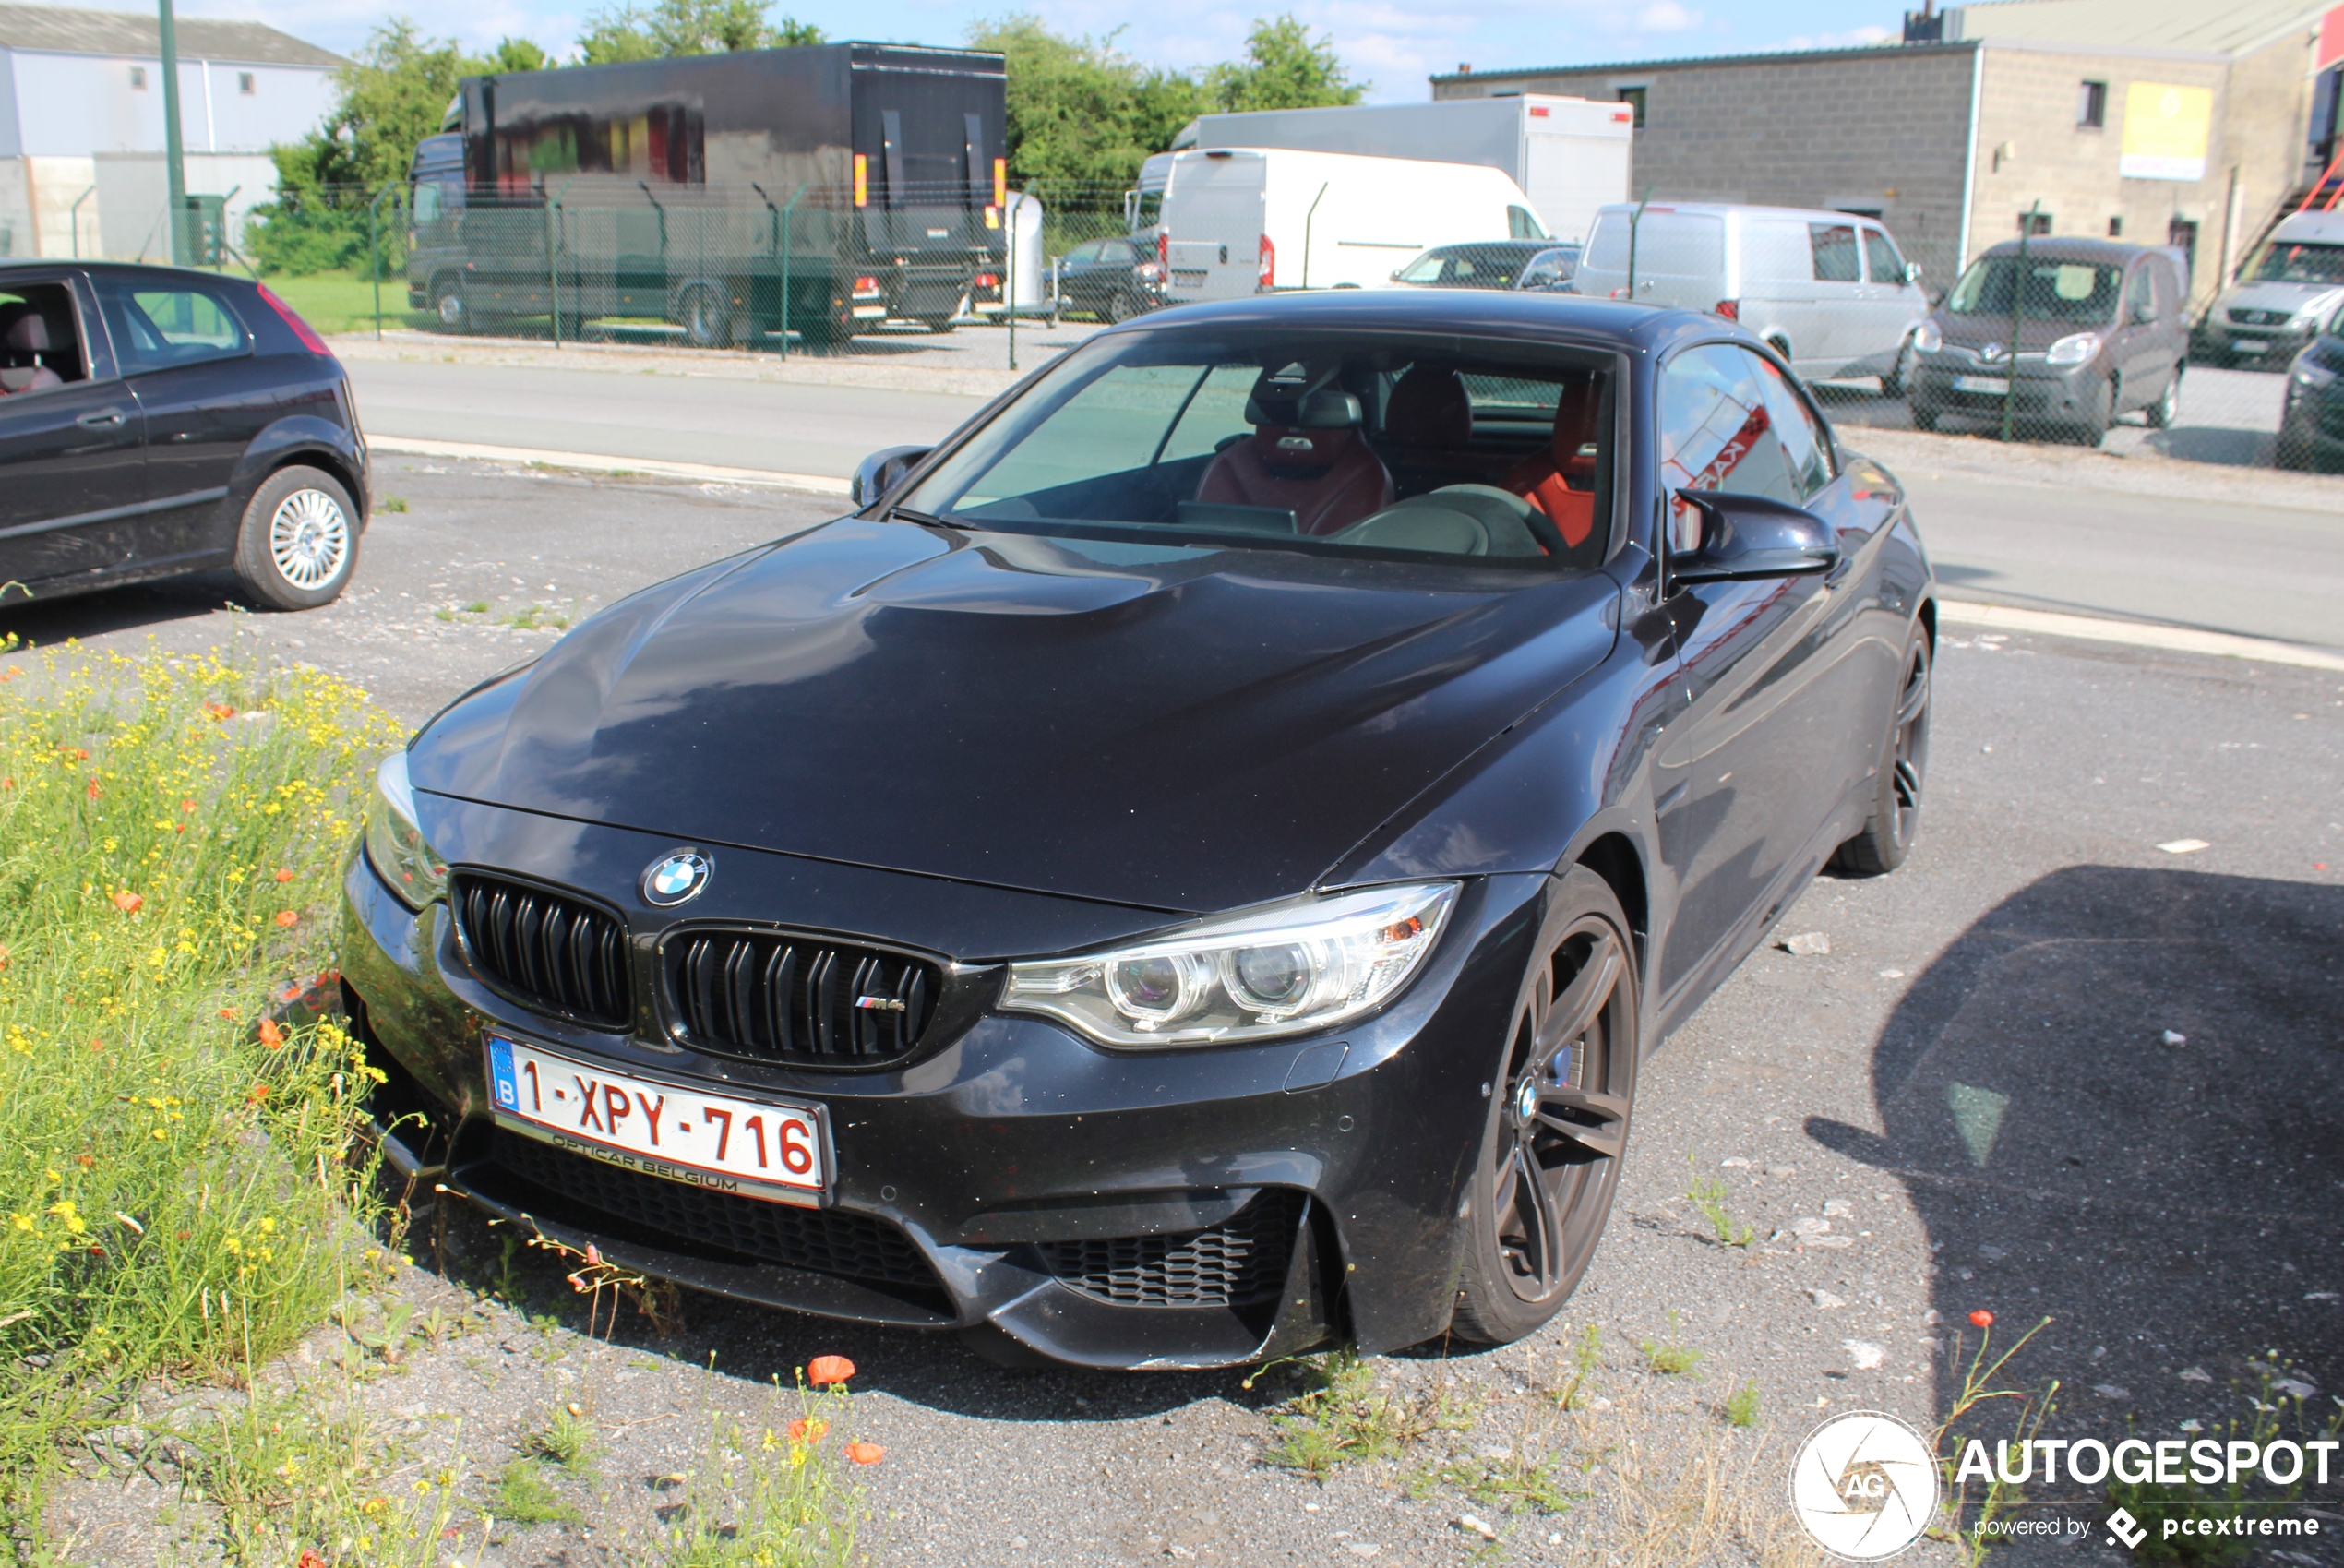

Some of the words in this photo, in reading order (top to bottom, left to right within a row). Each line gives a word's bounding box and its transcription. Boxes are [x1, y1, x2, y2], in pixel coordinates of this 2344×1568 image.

[663, 855, 707, 874] BMW
[499, 1080, 515, 1106] B
[524, 1059, 813, 1175] 1-XPY-716
[552, 1134, 636, 1168] OPTICAR
[642, 1160, 738, 1192] BELGIUM
